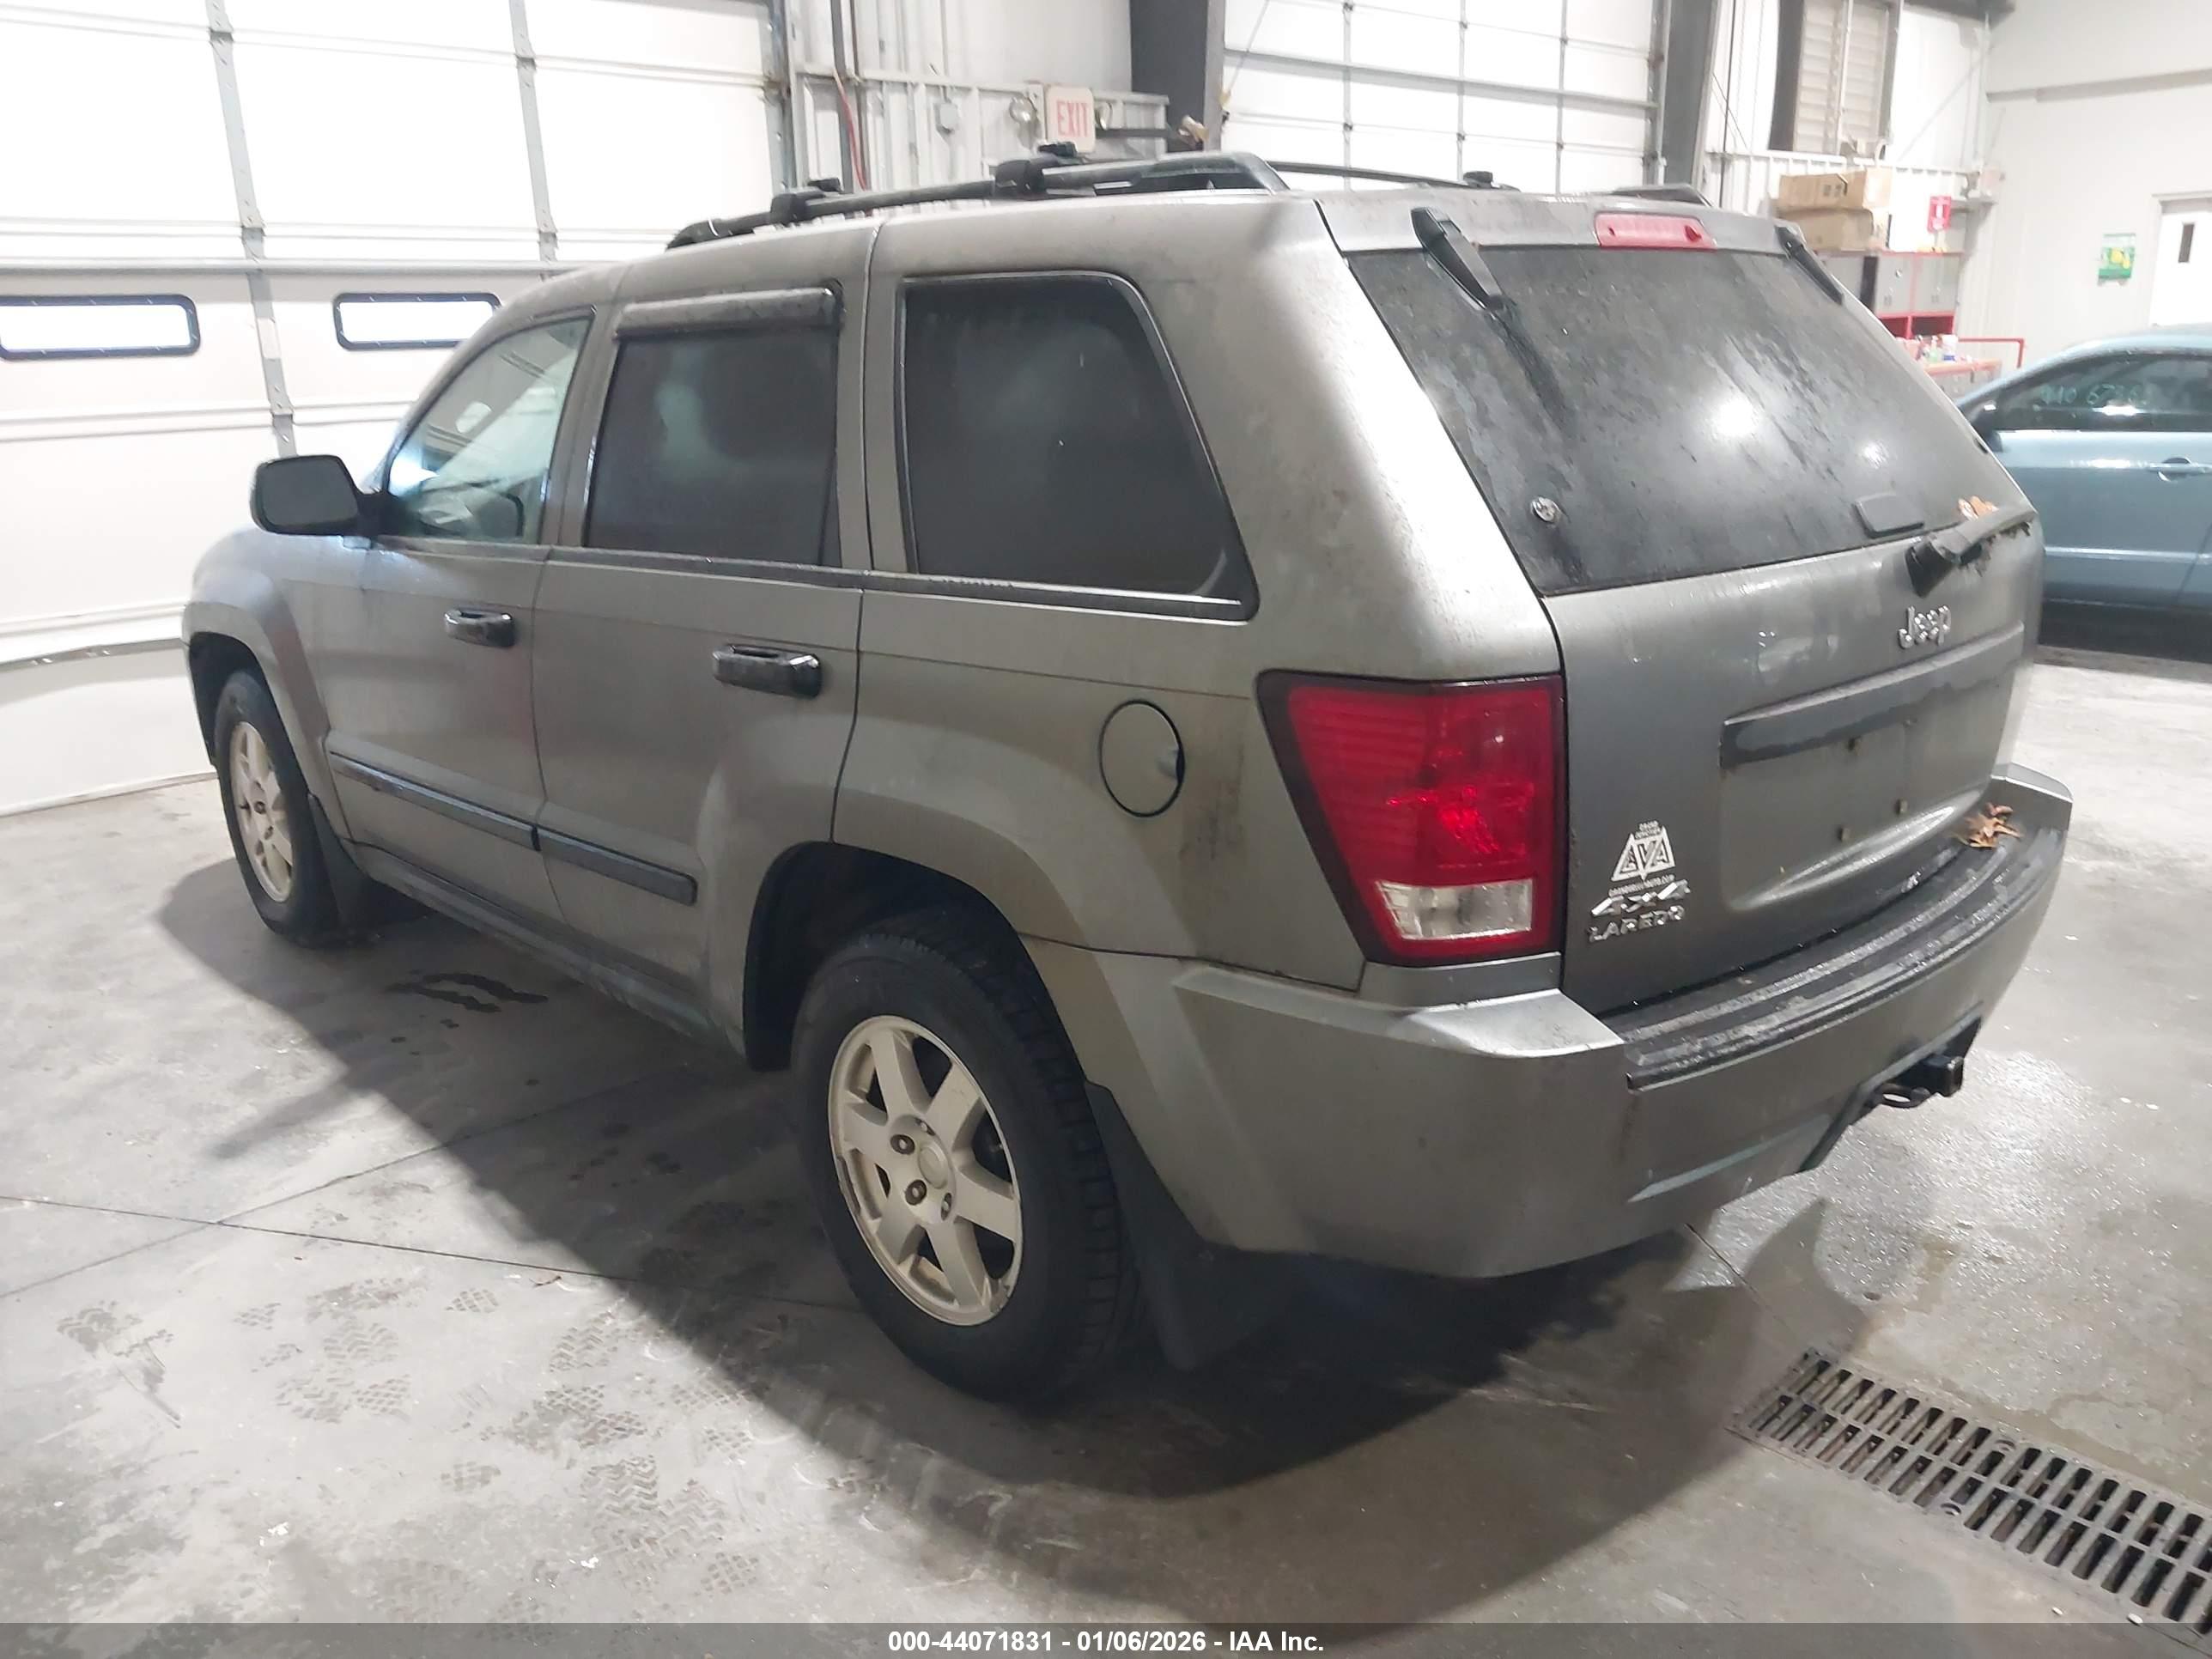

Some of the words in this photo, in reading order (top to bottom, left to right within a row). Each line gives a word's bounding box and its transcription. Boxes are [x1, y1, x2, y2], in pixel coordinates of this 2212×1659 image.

[1056, 100, 1088, 137] EXIT
[1898, 605, 1951, 648] Jeep
[1588, 905, 1685, 943] LAREDO
